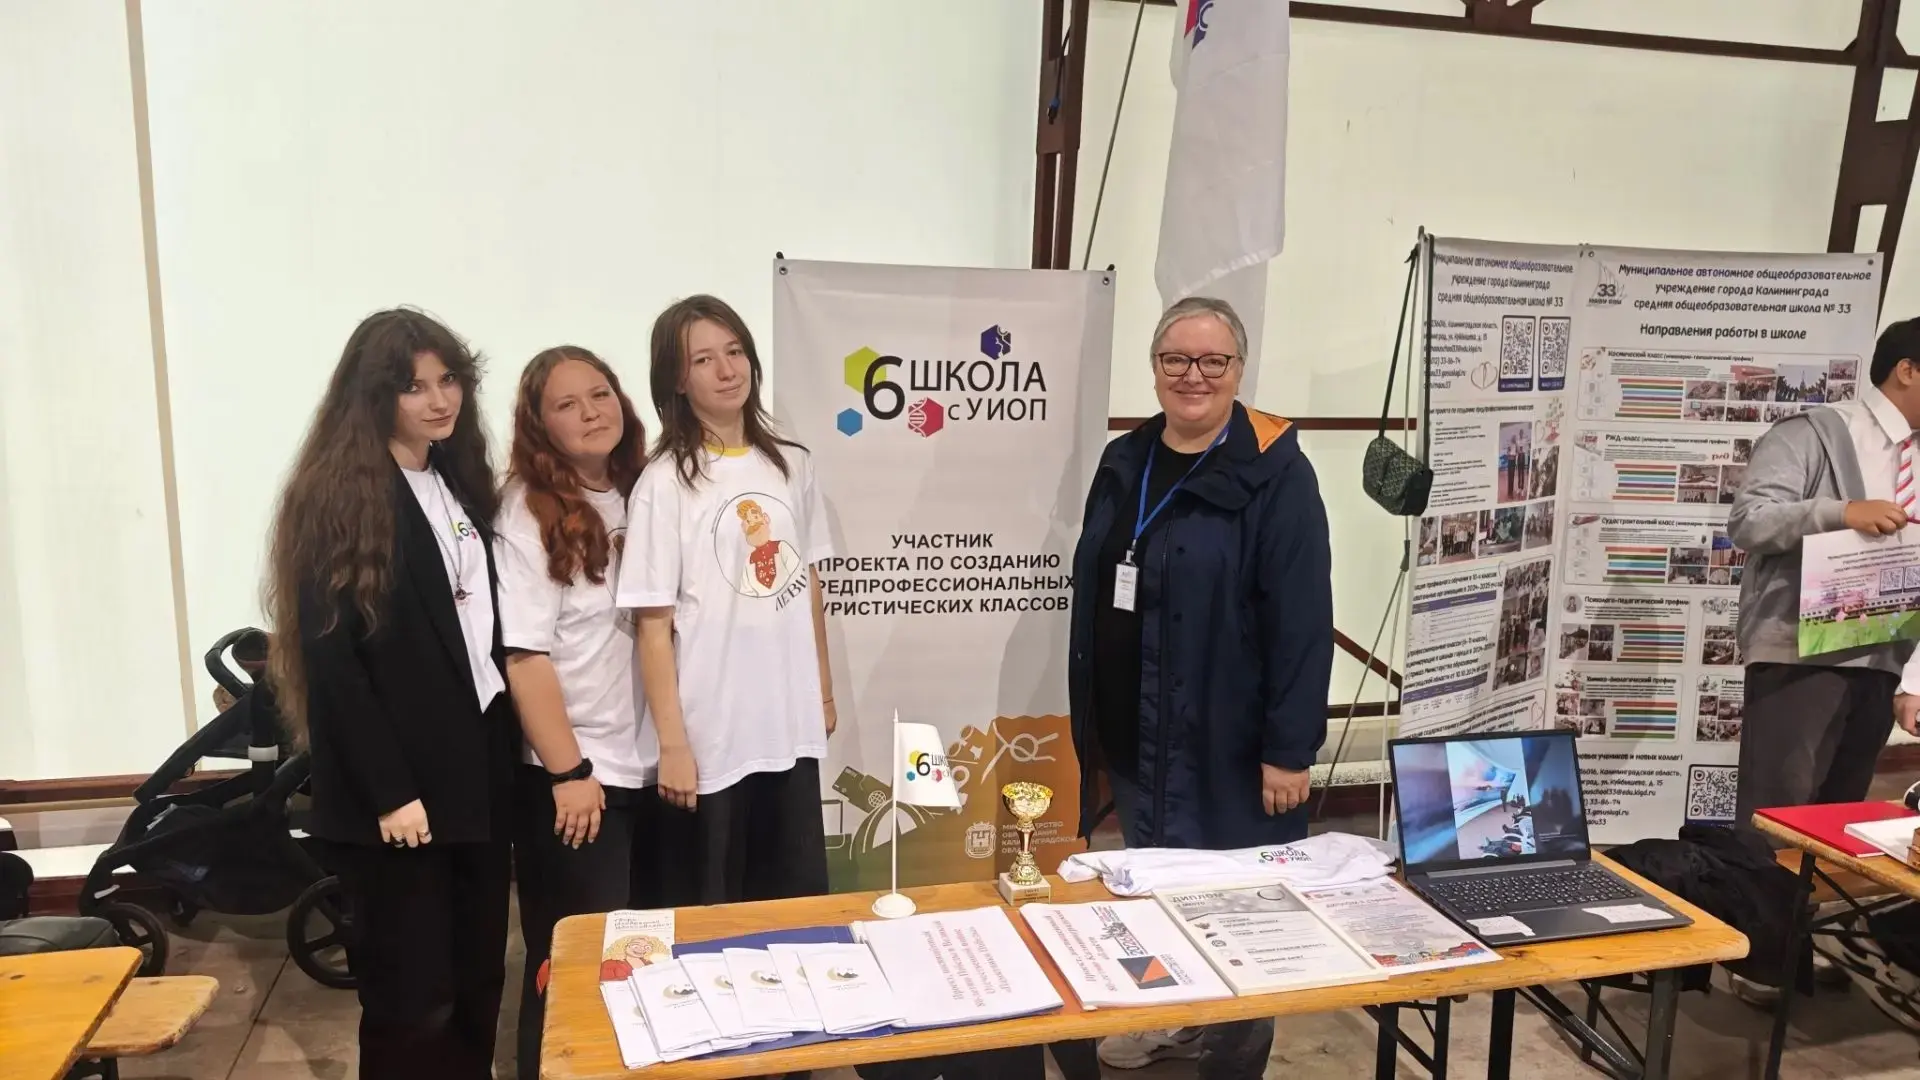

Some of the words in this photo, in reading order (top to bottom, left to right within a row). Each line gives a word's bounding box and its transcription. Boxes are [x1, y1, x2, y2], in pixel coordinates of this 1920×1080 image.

[1619, 264, 1694, 276] Муниципальное
[1696, 268, 1754, 278] автономное
[1756, 269, 1872, 280] общеобразовательное
[1597, 284, 1616, 297] 33
[1656, 284, 1714, 295] учреждение
[1718, 285, 1753, 296] города
[1756, 286, 1829, 298] Калининграда
[1554, 296, 1564, 307] 33
[1634, 299, 1672, 311] средняя
[1675, 300, 1786, 312] общеобразовательная
[1789, 304, 1820, 313] школа
[1823, 304, 1834, 313] №
[1838, 304, 1852, 314] 33
[1640, 324, 1712, 338] Направления
[1715, 326, 1758, 340] работы
[1760, 328, 1768, 338] в
[1770, 330, 1806, 340] школе
[864, 356, 906, 420] 6
[910, 360, 1046, 392] ШКОЛА
[967, 398, 1046, 422] УИОП
[458, 522, 469, 536] 6
[891, 534, 994, 548] УЧАСТНИК
[818, 556, 909, 572] ПРОЕКТА
[916, 556, 944, 571] ПО
[950, 554, 1060, 572] СОЗДАНИЮ
[820, 574, 1074, 596] РЕДПРОФЕССИОНАЛЬНЫХ
[980, 597, 1069, 613] КЛАССОВ
[916, 752, 930, 776] 6
[1260, 852, 1274, 861] 6
